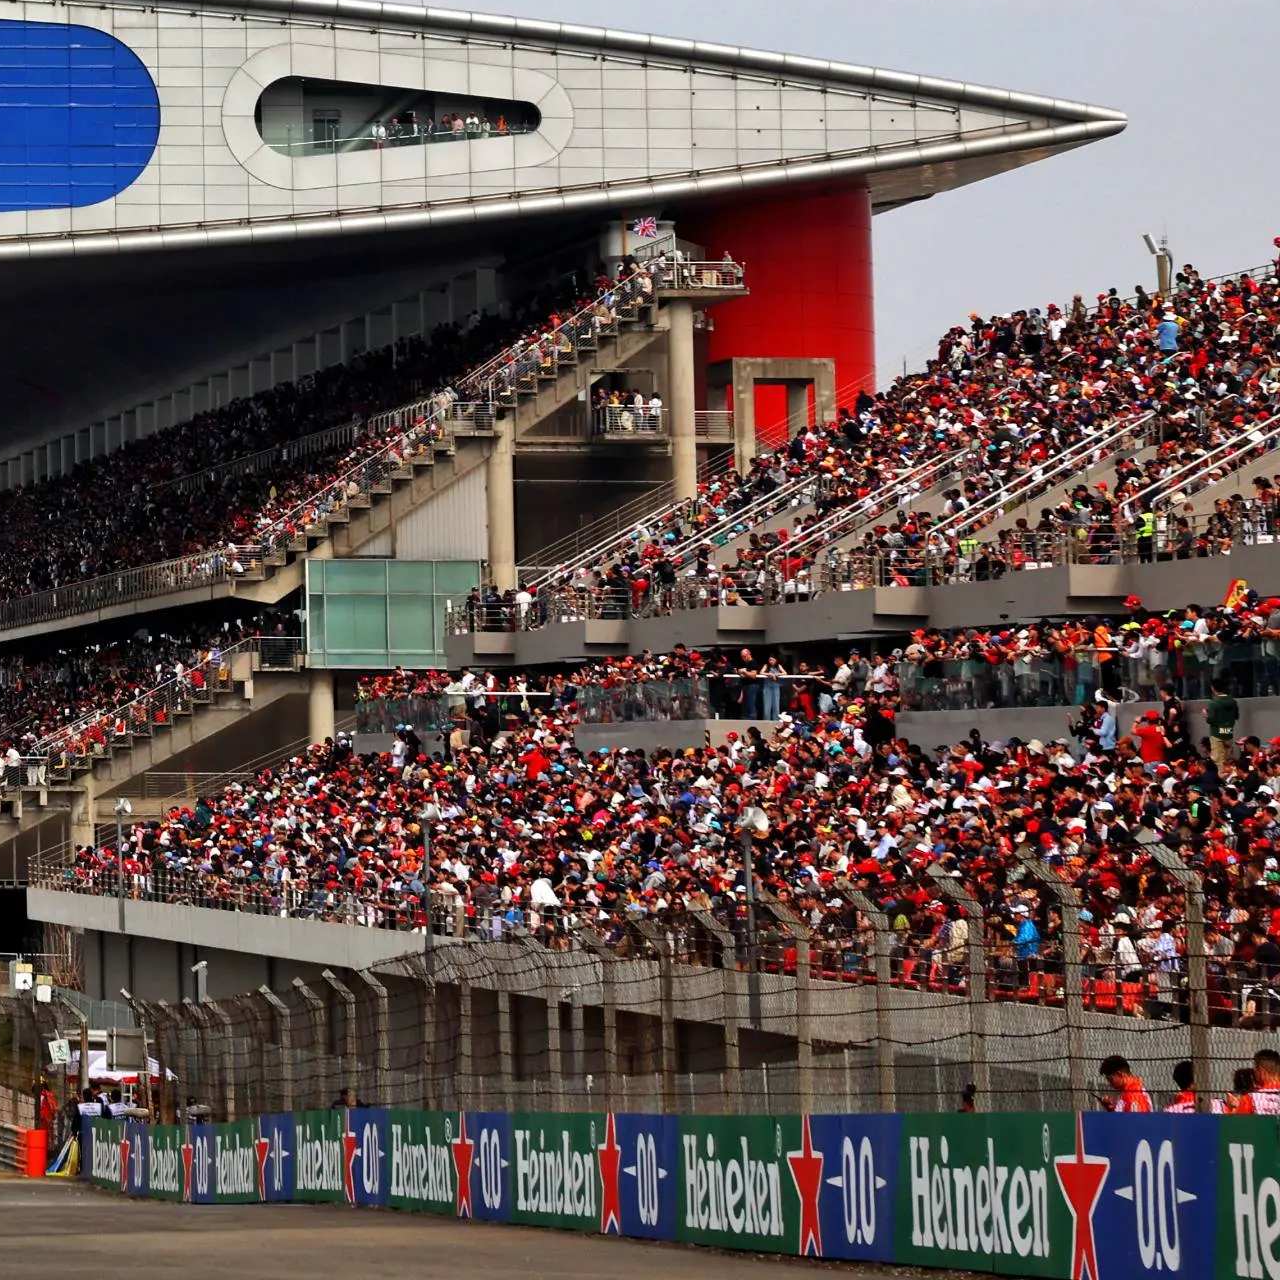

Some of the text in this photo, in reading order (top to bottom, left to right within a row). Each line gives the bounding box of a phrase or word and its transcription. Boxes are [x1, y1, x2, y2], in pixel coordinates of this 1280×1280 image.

[362, 1122, 380, 1195] 0.0
[480, 1129, 501, 1209] 0.0
[636, 1133, 659, 1225] 0.0
[842, 1136, 875, 1245] 0.0
[1135, 1140, 1182, 1271] 0.0
